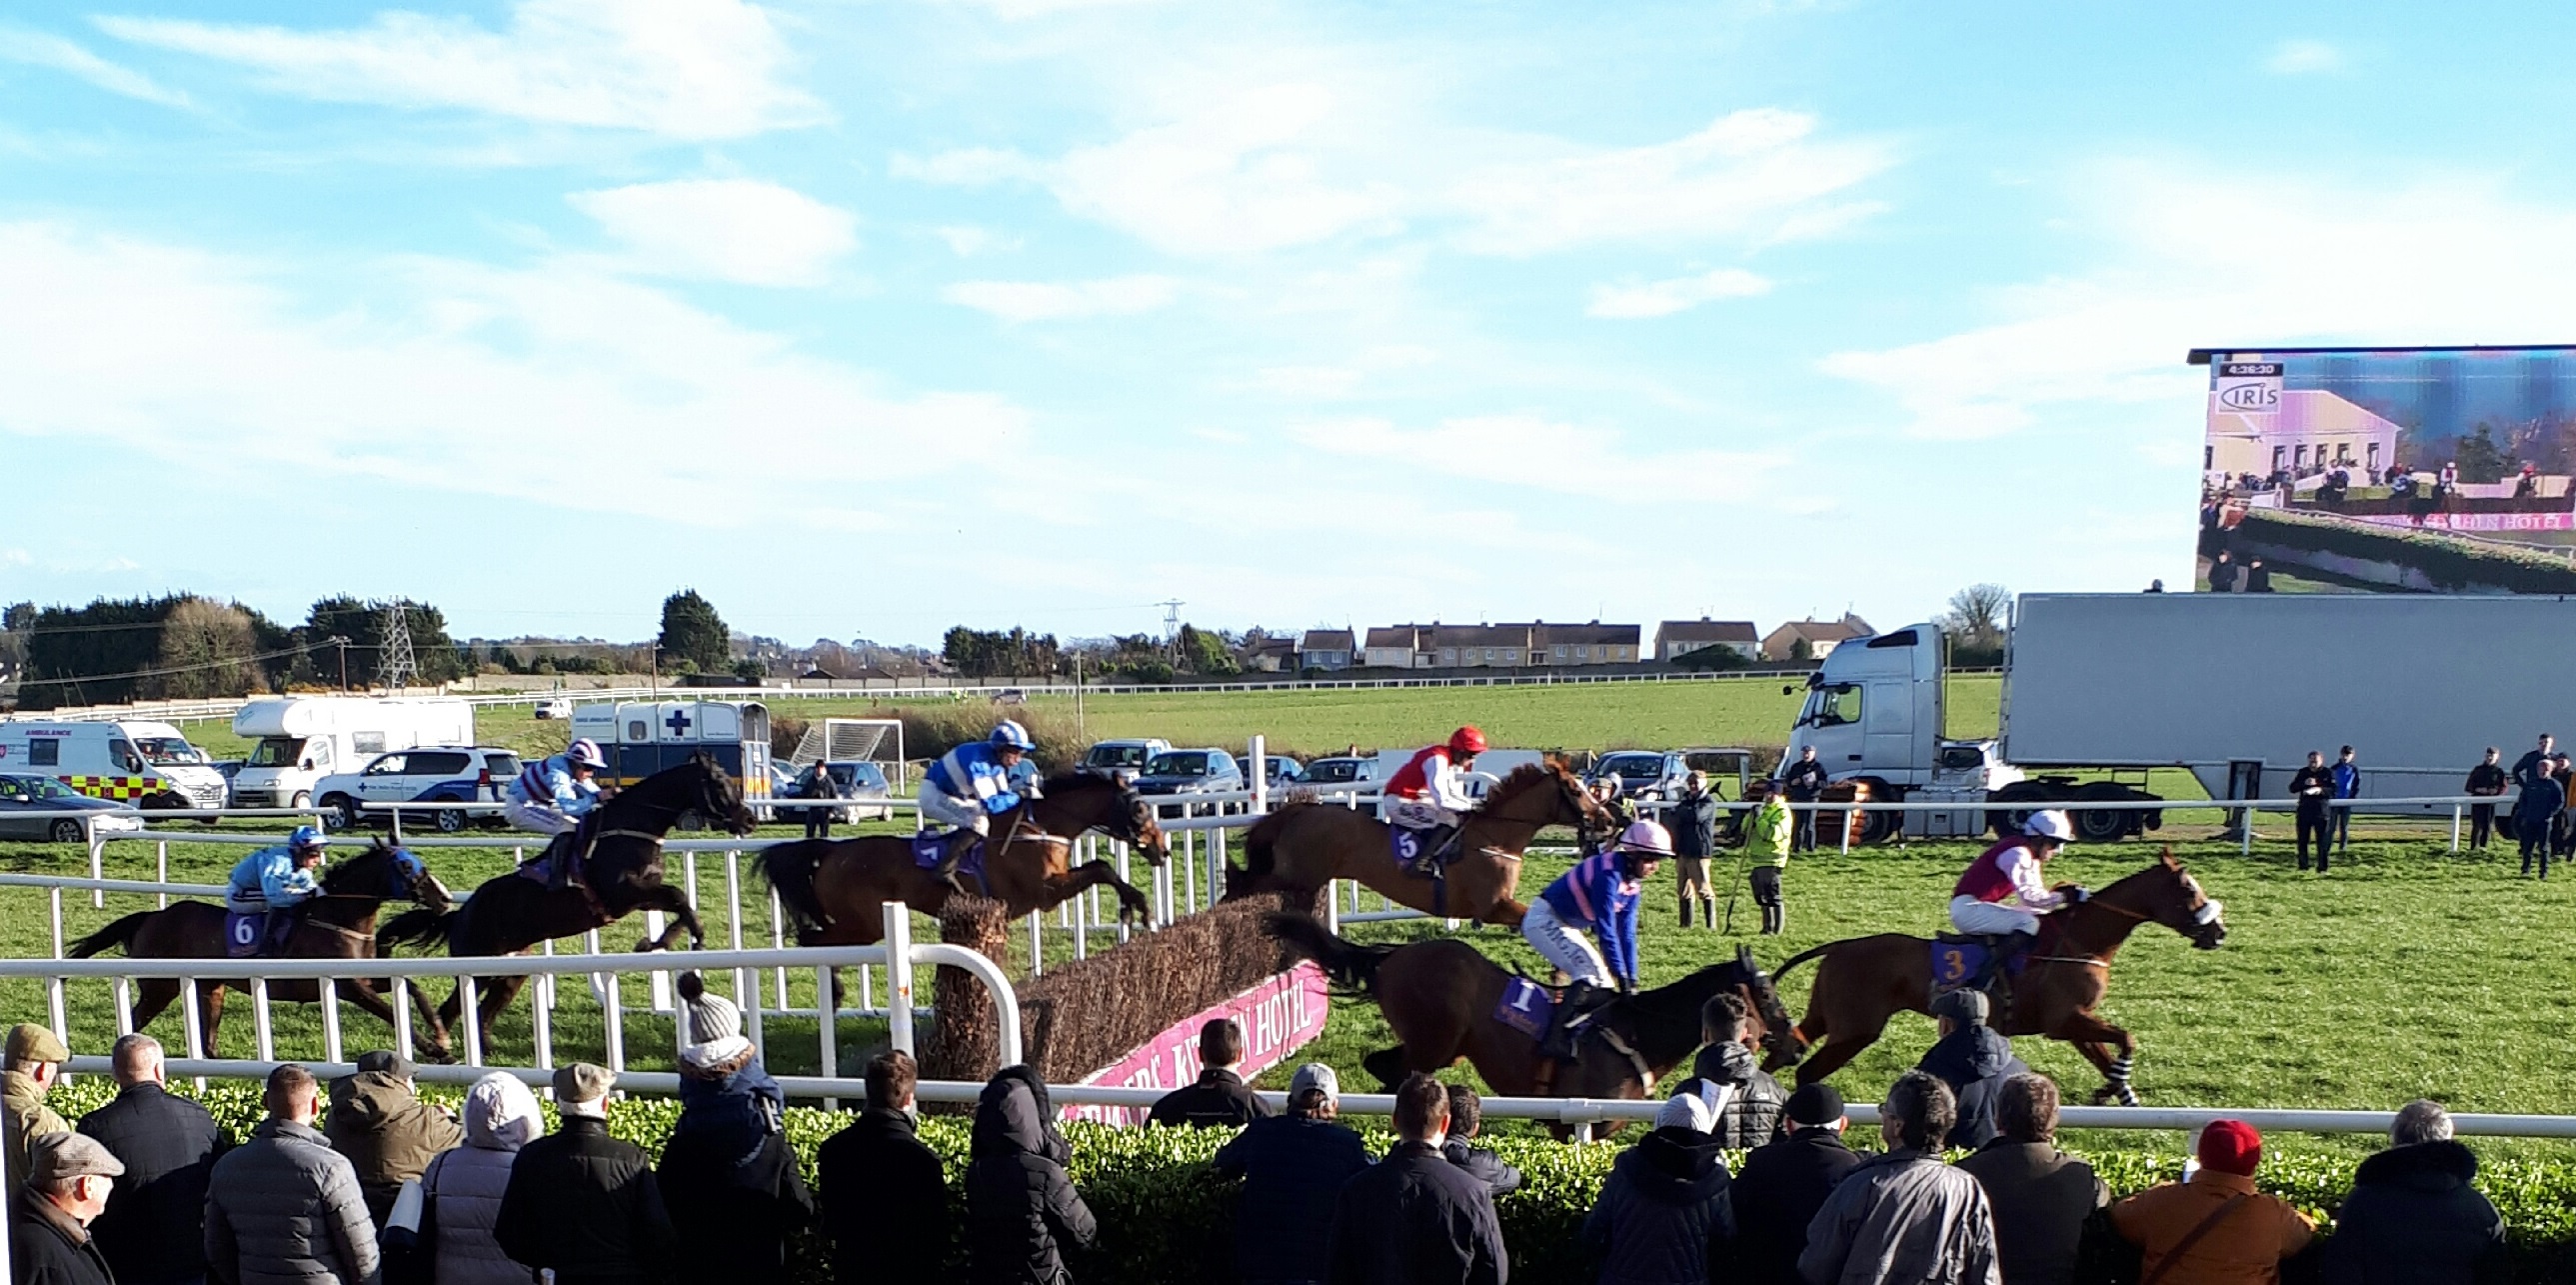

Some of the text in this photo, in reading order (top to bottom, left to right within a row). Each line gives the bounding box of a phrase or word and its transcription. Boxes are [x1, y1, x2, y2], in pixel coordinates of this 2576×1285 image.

[2234, 384, 2278, 405] IRIS
[1398, 832, 1417, 858] 5
[235, 916, 254, 944] 6
[1944, 950, 1966, 980] 3
[1510, 982, 1535, 1012] 1
[1256, 978, 1313, 1056] HOTEL
